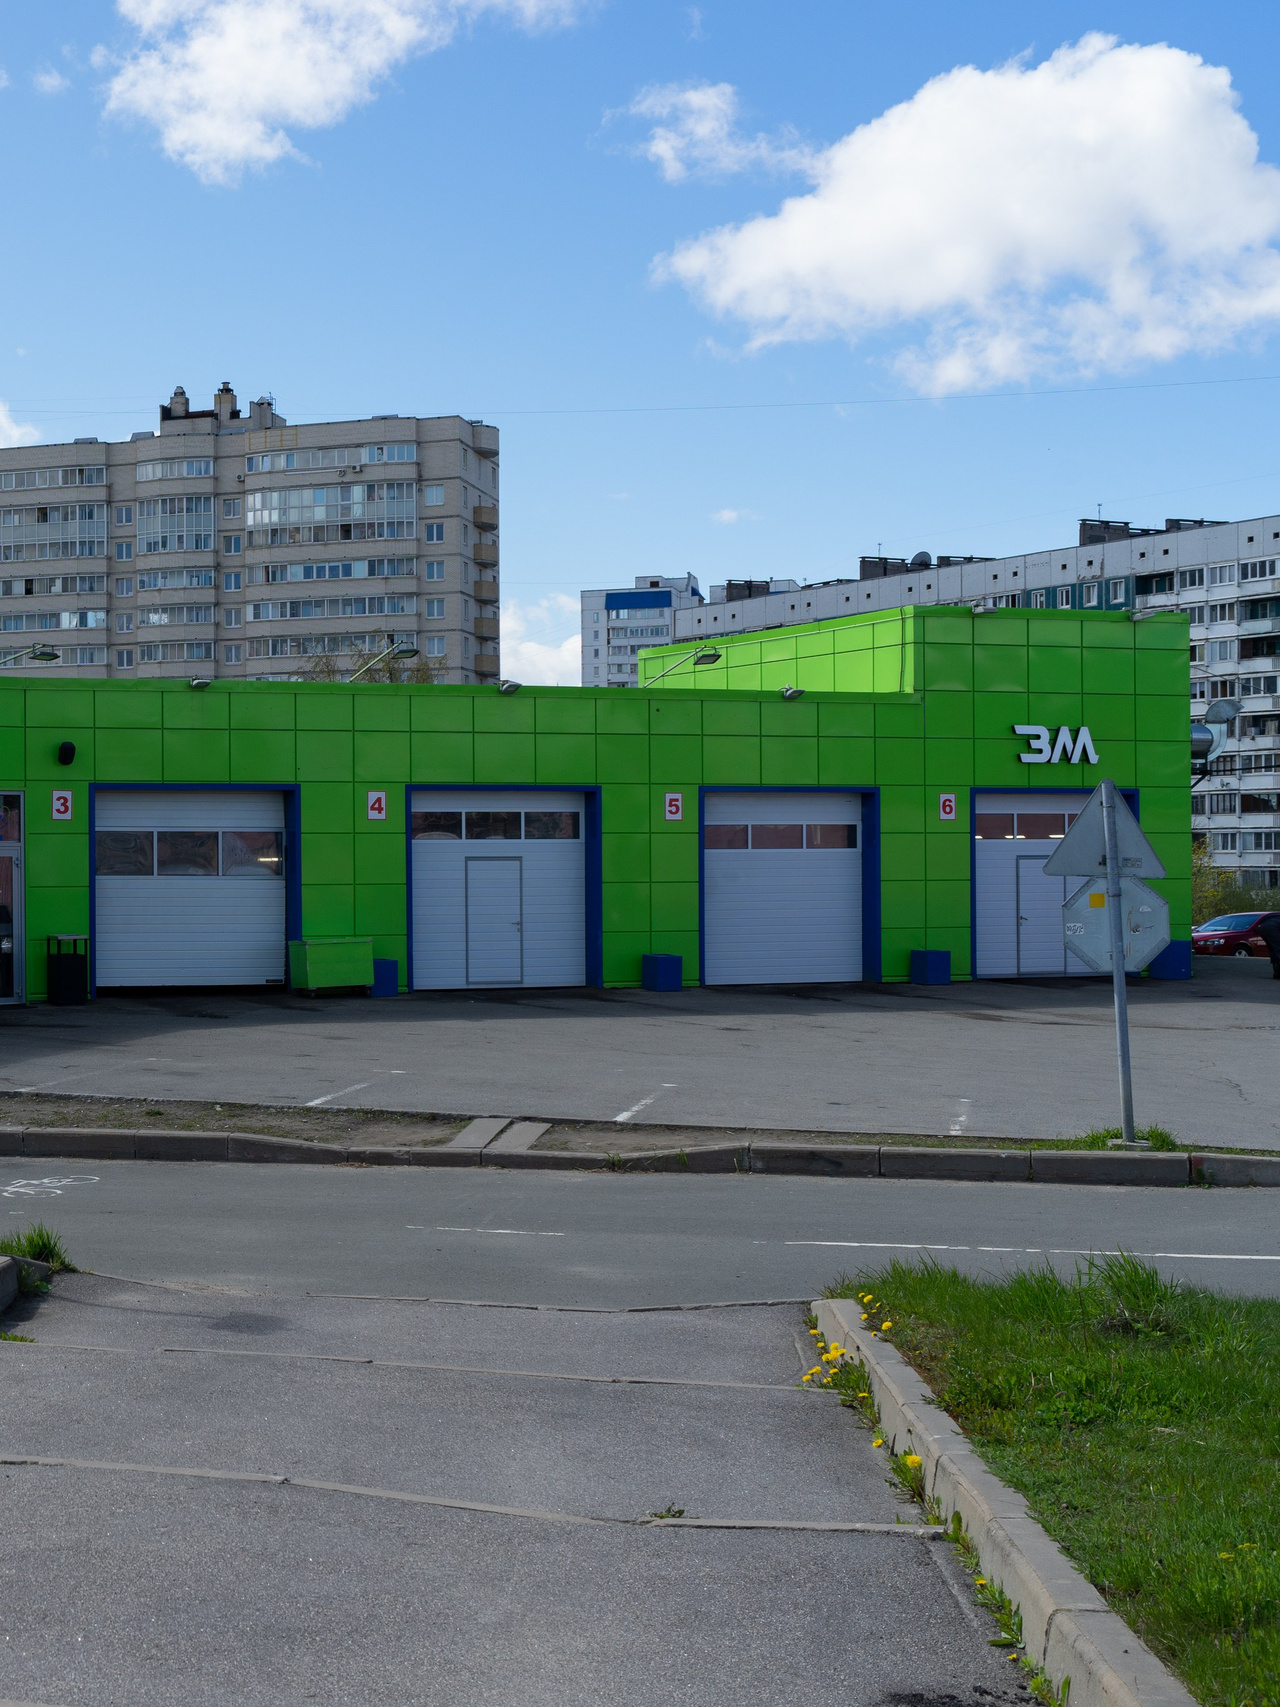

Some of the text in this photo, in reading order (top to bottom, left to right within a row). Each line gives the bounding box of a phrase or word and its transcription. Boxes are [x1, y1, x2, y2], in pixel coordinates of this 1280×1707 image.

[55, 796, 70, 815] 3
[369, 796, 384, 815] 4
[667, 797, 681, 815] 5
[941, 798, 954, 815] 6
